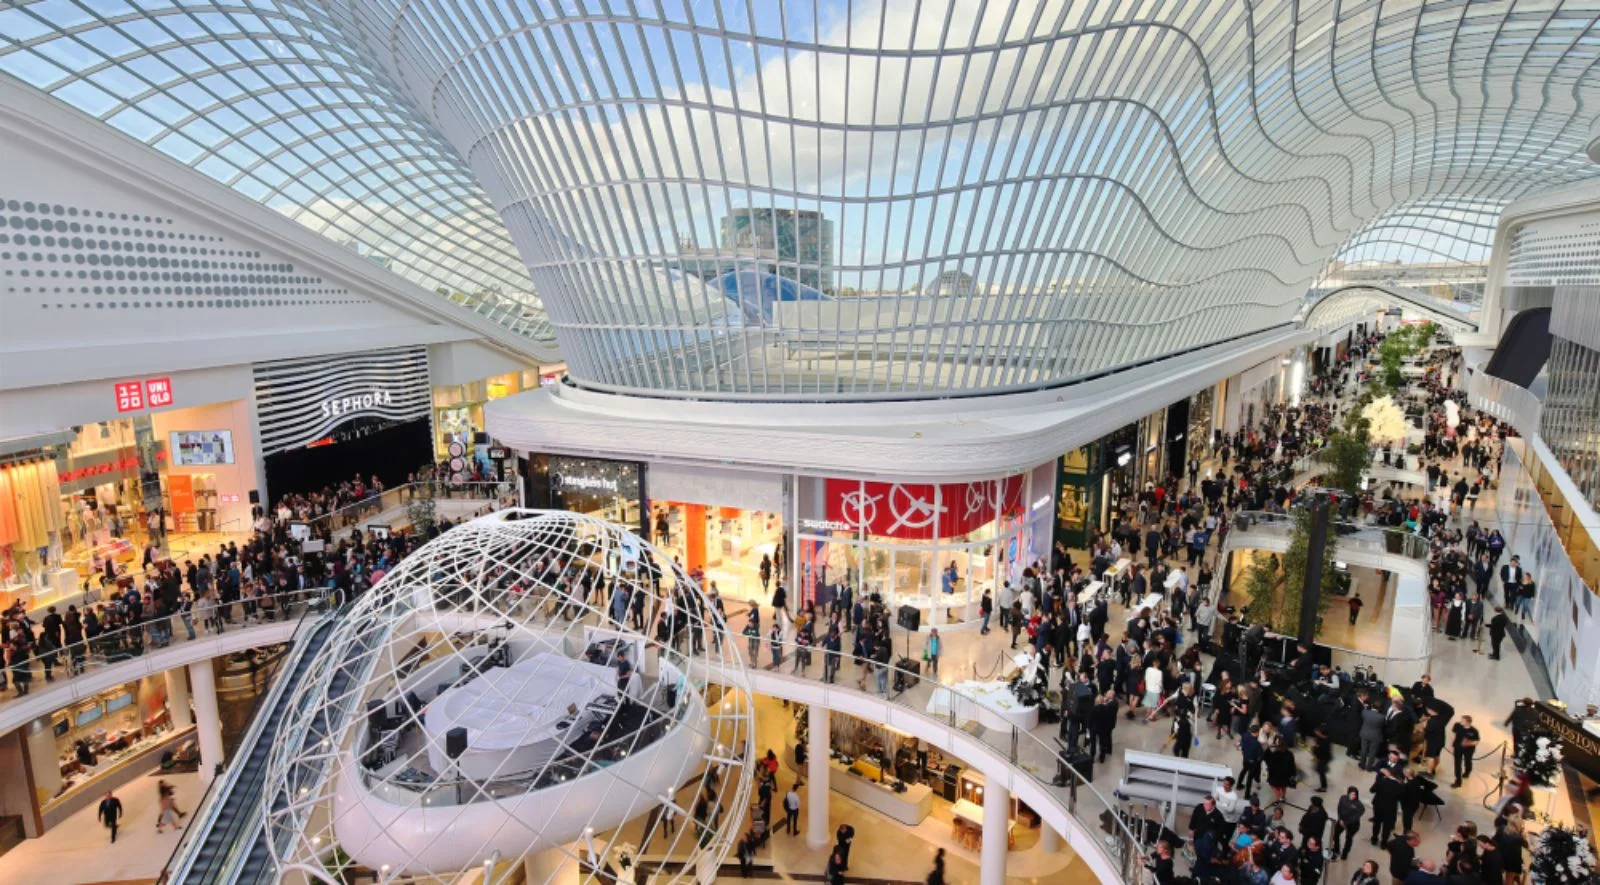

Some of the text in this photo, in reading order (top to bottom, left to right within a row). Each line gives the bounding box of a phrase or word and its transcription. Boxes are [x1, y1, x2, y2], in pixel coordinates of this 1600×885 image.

[149, 382, 167, 393] UNI
[151, 392, 170, 405] QLO
[321, 390, 391, 417] SEPHORA
[564, 475, 601, 489] sunglass
[803, 519, 844, 530] swatch
